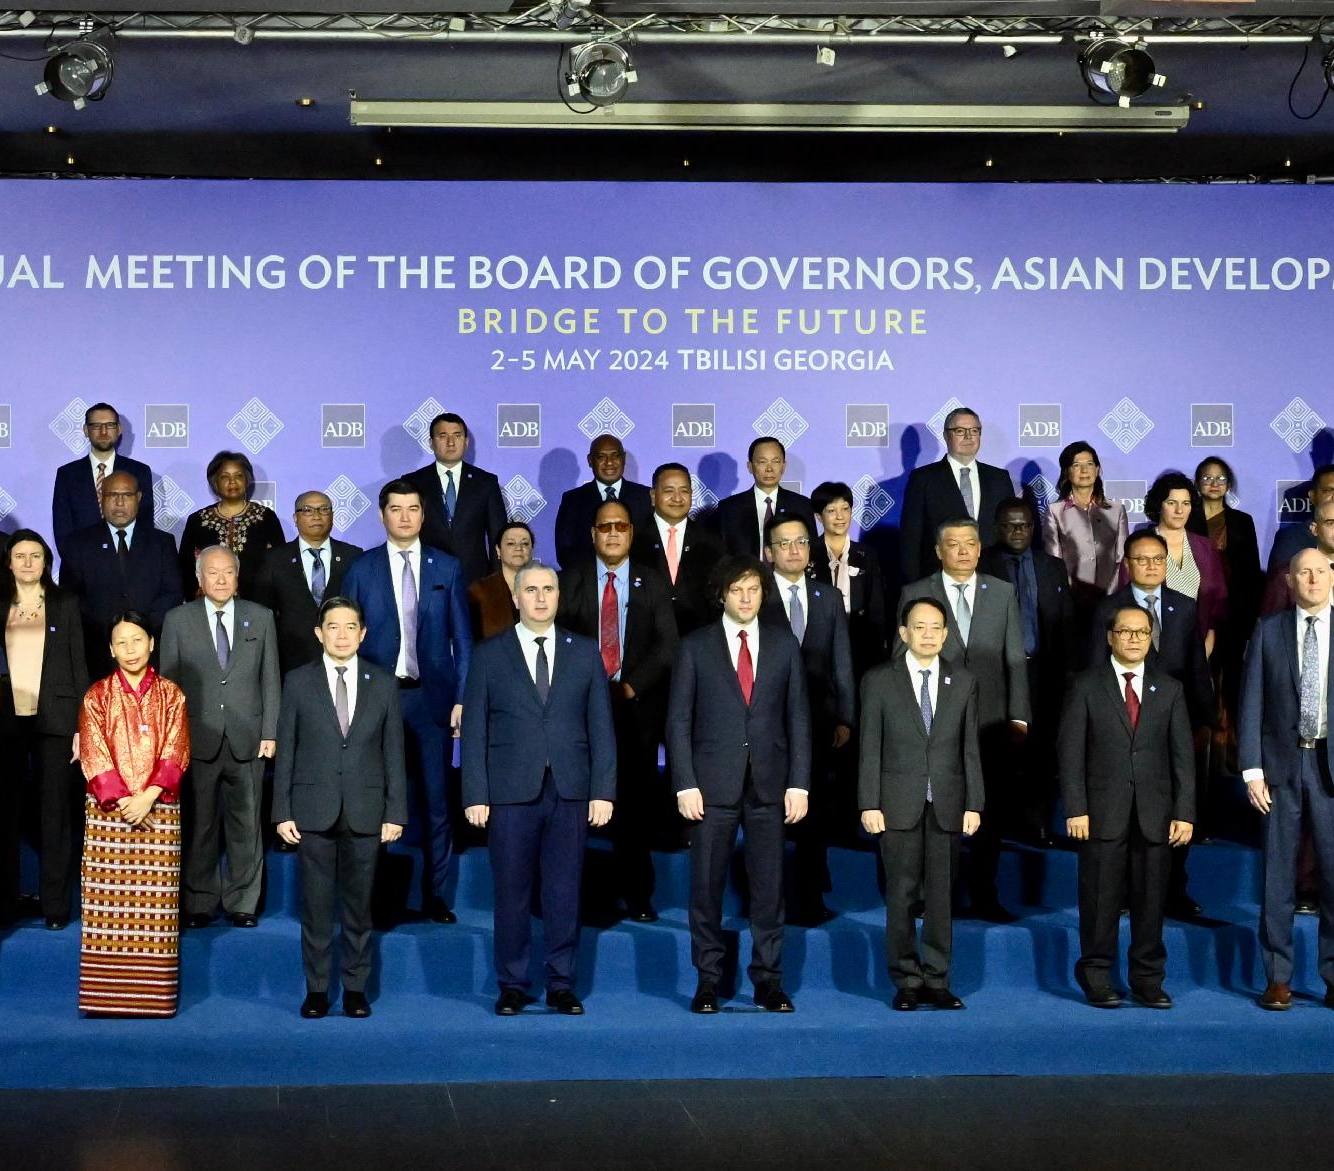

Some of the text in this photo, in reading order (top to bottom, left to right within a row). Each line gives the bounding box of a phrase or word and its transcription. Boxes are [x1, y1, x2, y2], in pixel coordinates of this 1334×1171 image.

[85, 254, 286, 289] MEETING
[298, 254, 357, 289] OF
[367, 255, 456, 289] THE
[469, 255, 622, 290] BOARD
[633, 255, 692, 290] OF
[702, 255, 983, 295] GOVERNORS,
[990, 256, 1124, 291] ASIAN
[458, 308, 927, 335] BRIDGE TO THE FUTURE
[543, 348, 602, 371] MAY
[608, 349, 669, 371] 2024
[676, 348, 766, 371] TBILISI
[774, 349, 894, 371] GEORGIA
[146, 421, 187, 437] ADB
[323, 421, 364, 437] ADB
[499, 421, 540, 437] ADB
[674, 421, 714, 437] ADB
[848, 421, 887, 437] ADB
[1020, 421, 1060, 437] ADB
[1192, 421, 1231, 437] ADB
[1121, 498, 1145, 513] DB
